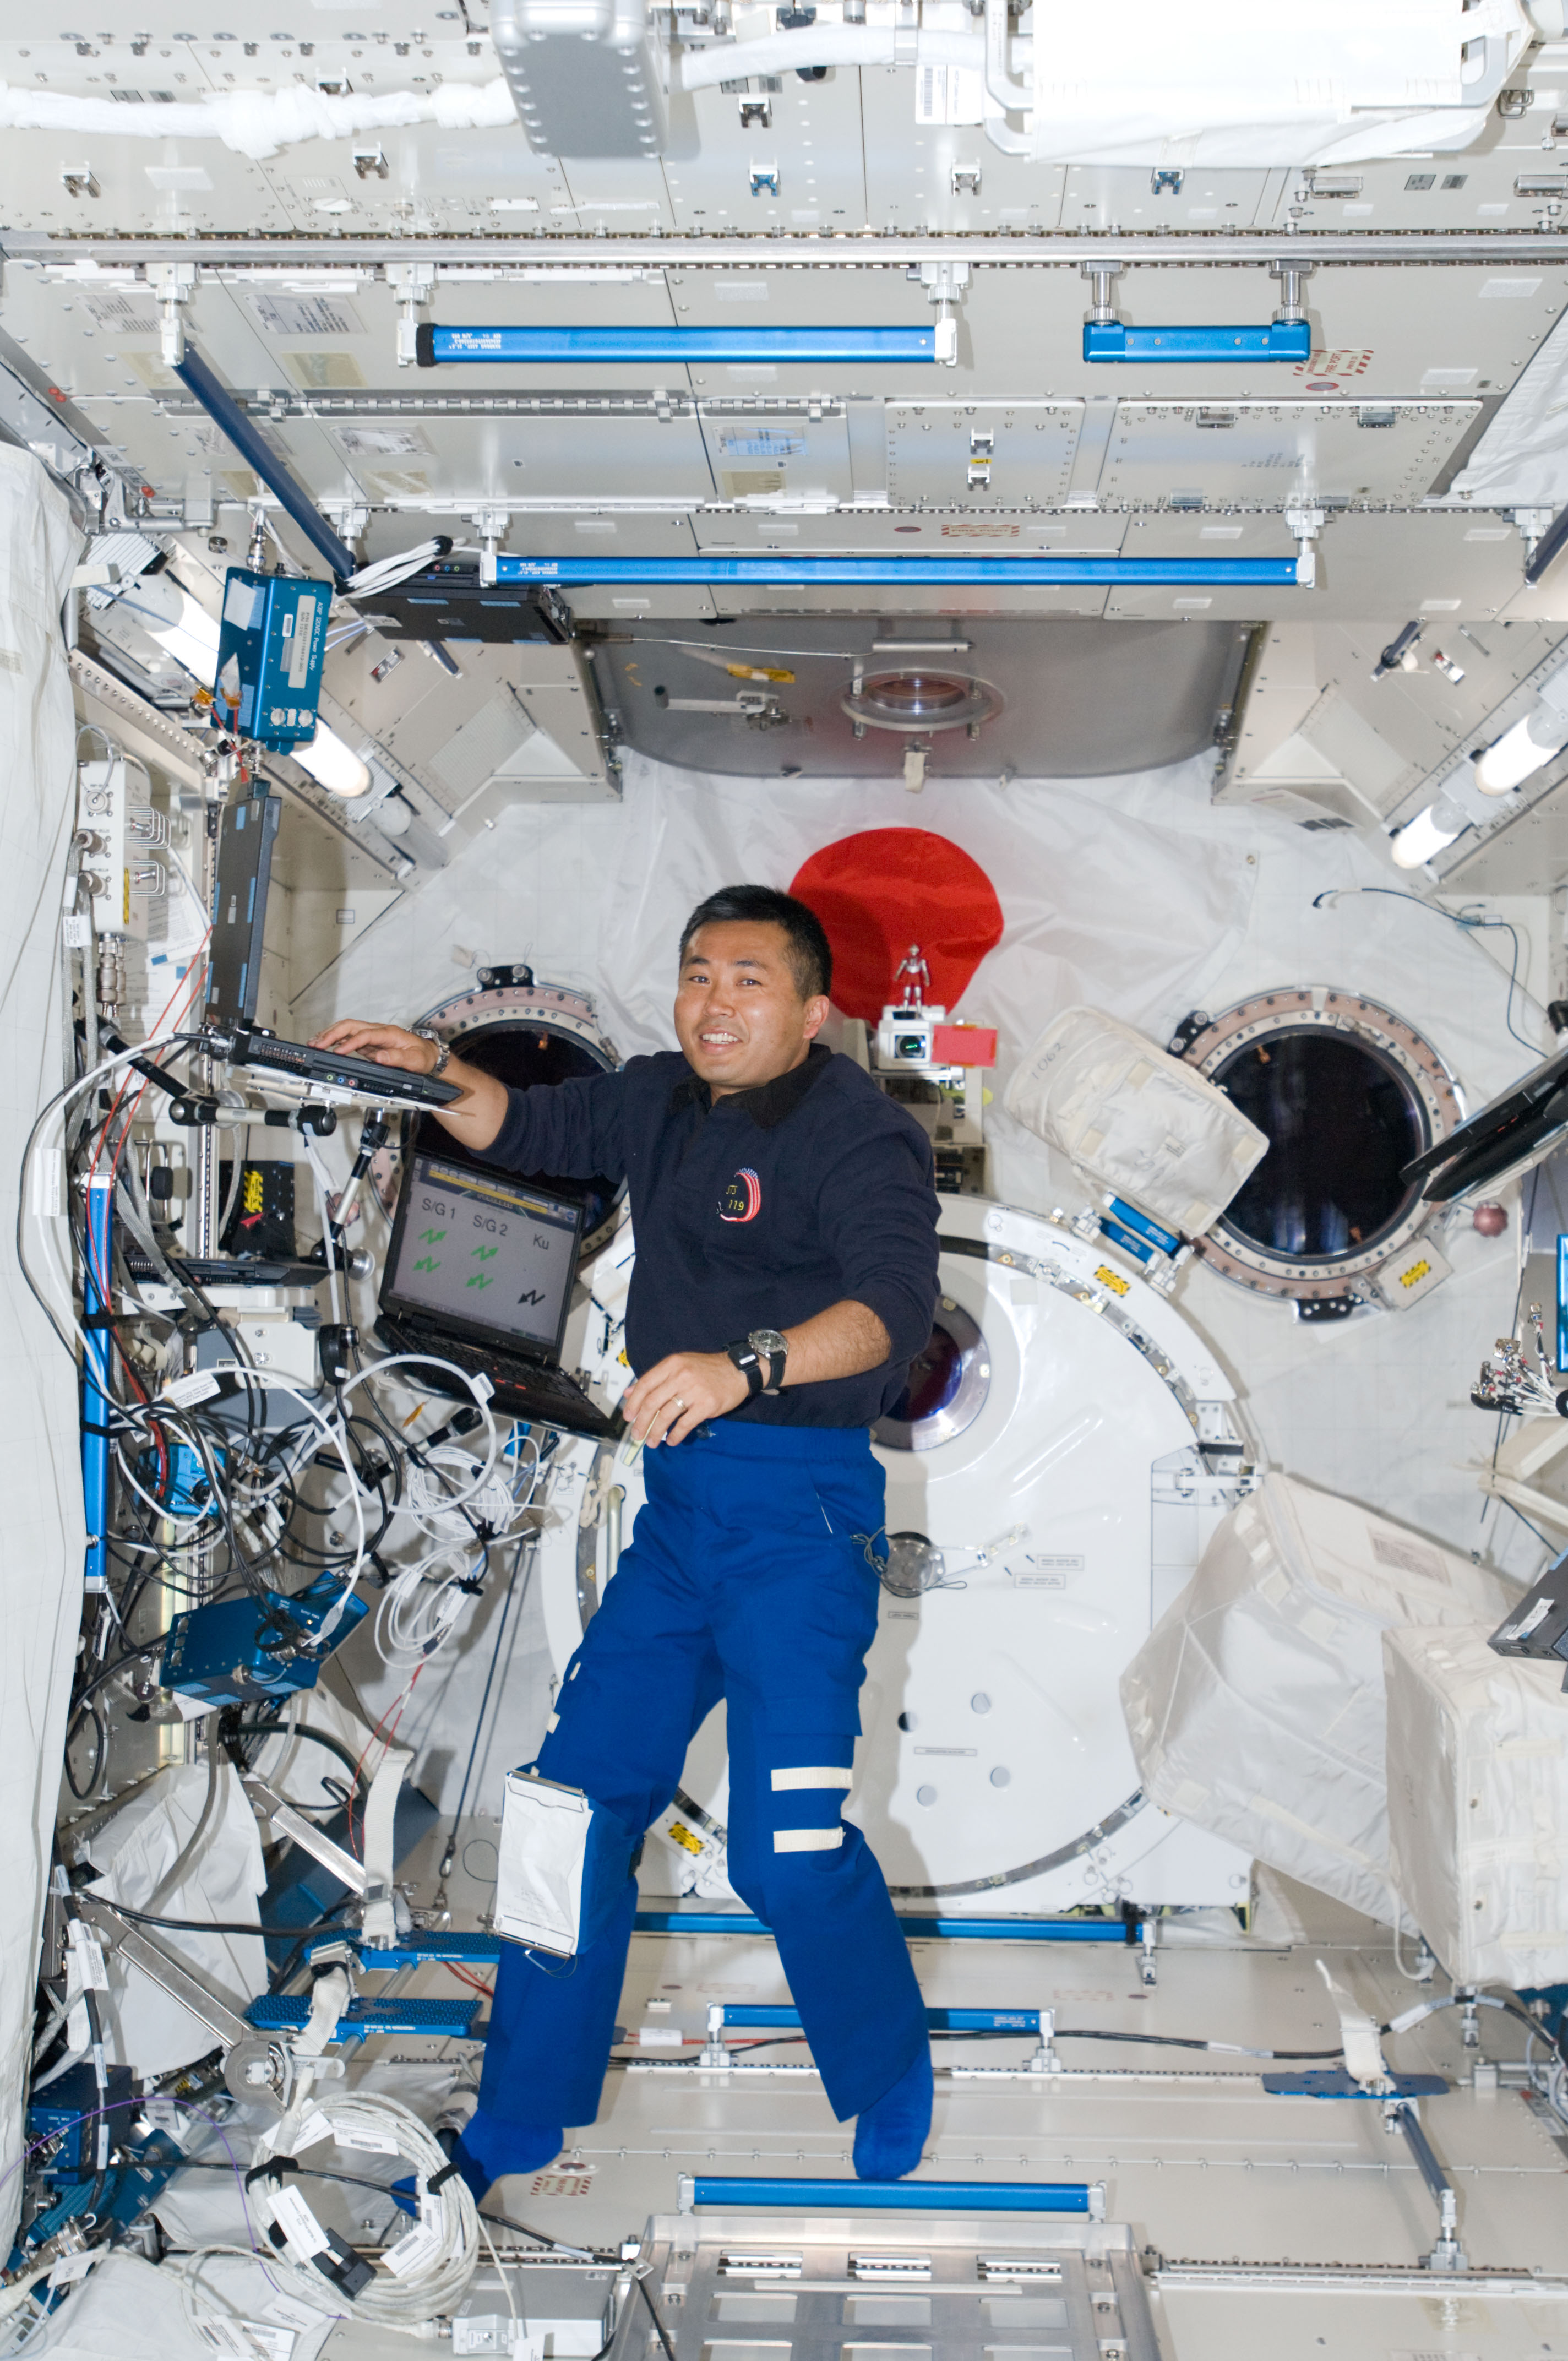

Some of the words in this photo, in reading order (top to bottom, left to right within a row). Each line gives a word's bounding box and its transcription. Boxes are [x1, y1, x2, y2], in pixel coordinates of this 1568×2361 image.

[1329, 353, 1342, 364] PORT
[309, 654, 318, 671] Supply
[422, 1198, 445, 1216] S/G
[451, 1207, 456, 1220] 1
[728, 1199, 744, 1211] 119
[473, 1214, 497, 1233] S/G
[499, 1223, 508, 1237] 2
[533, 1233, 550, 1250] Ku
